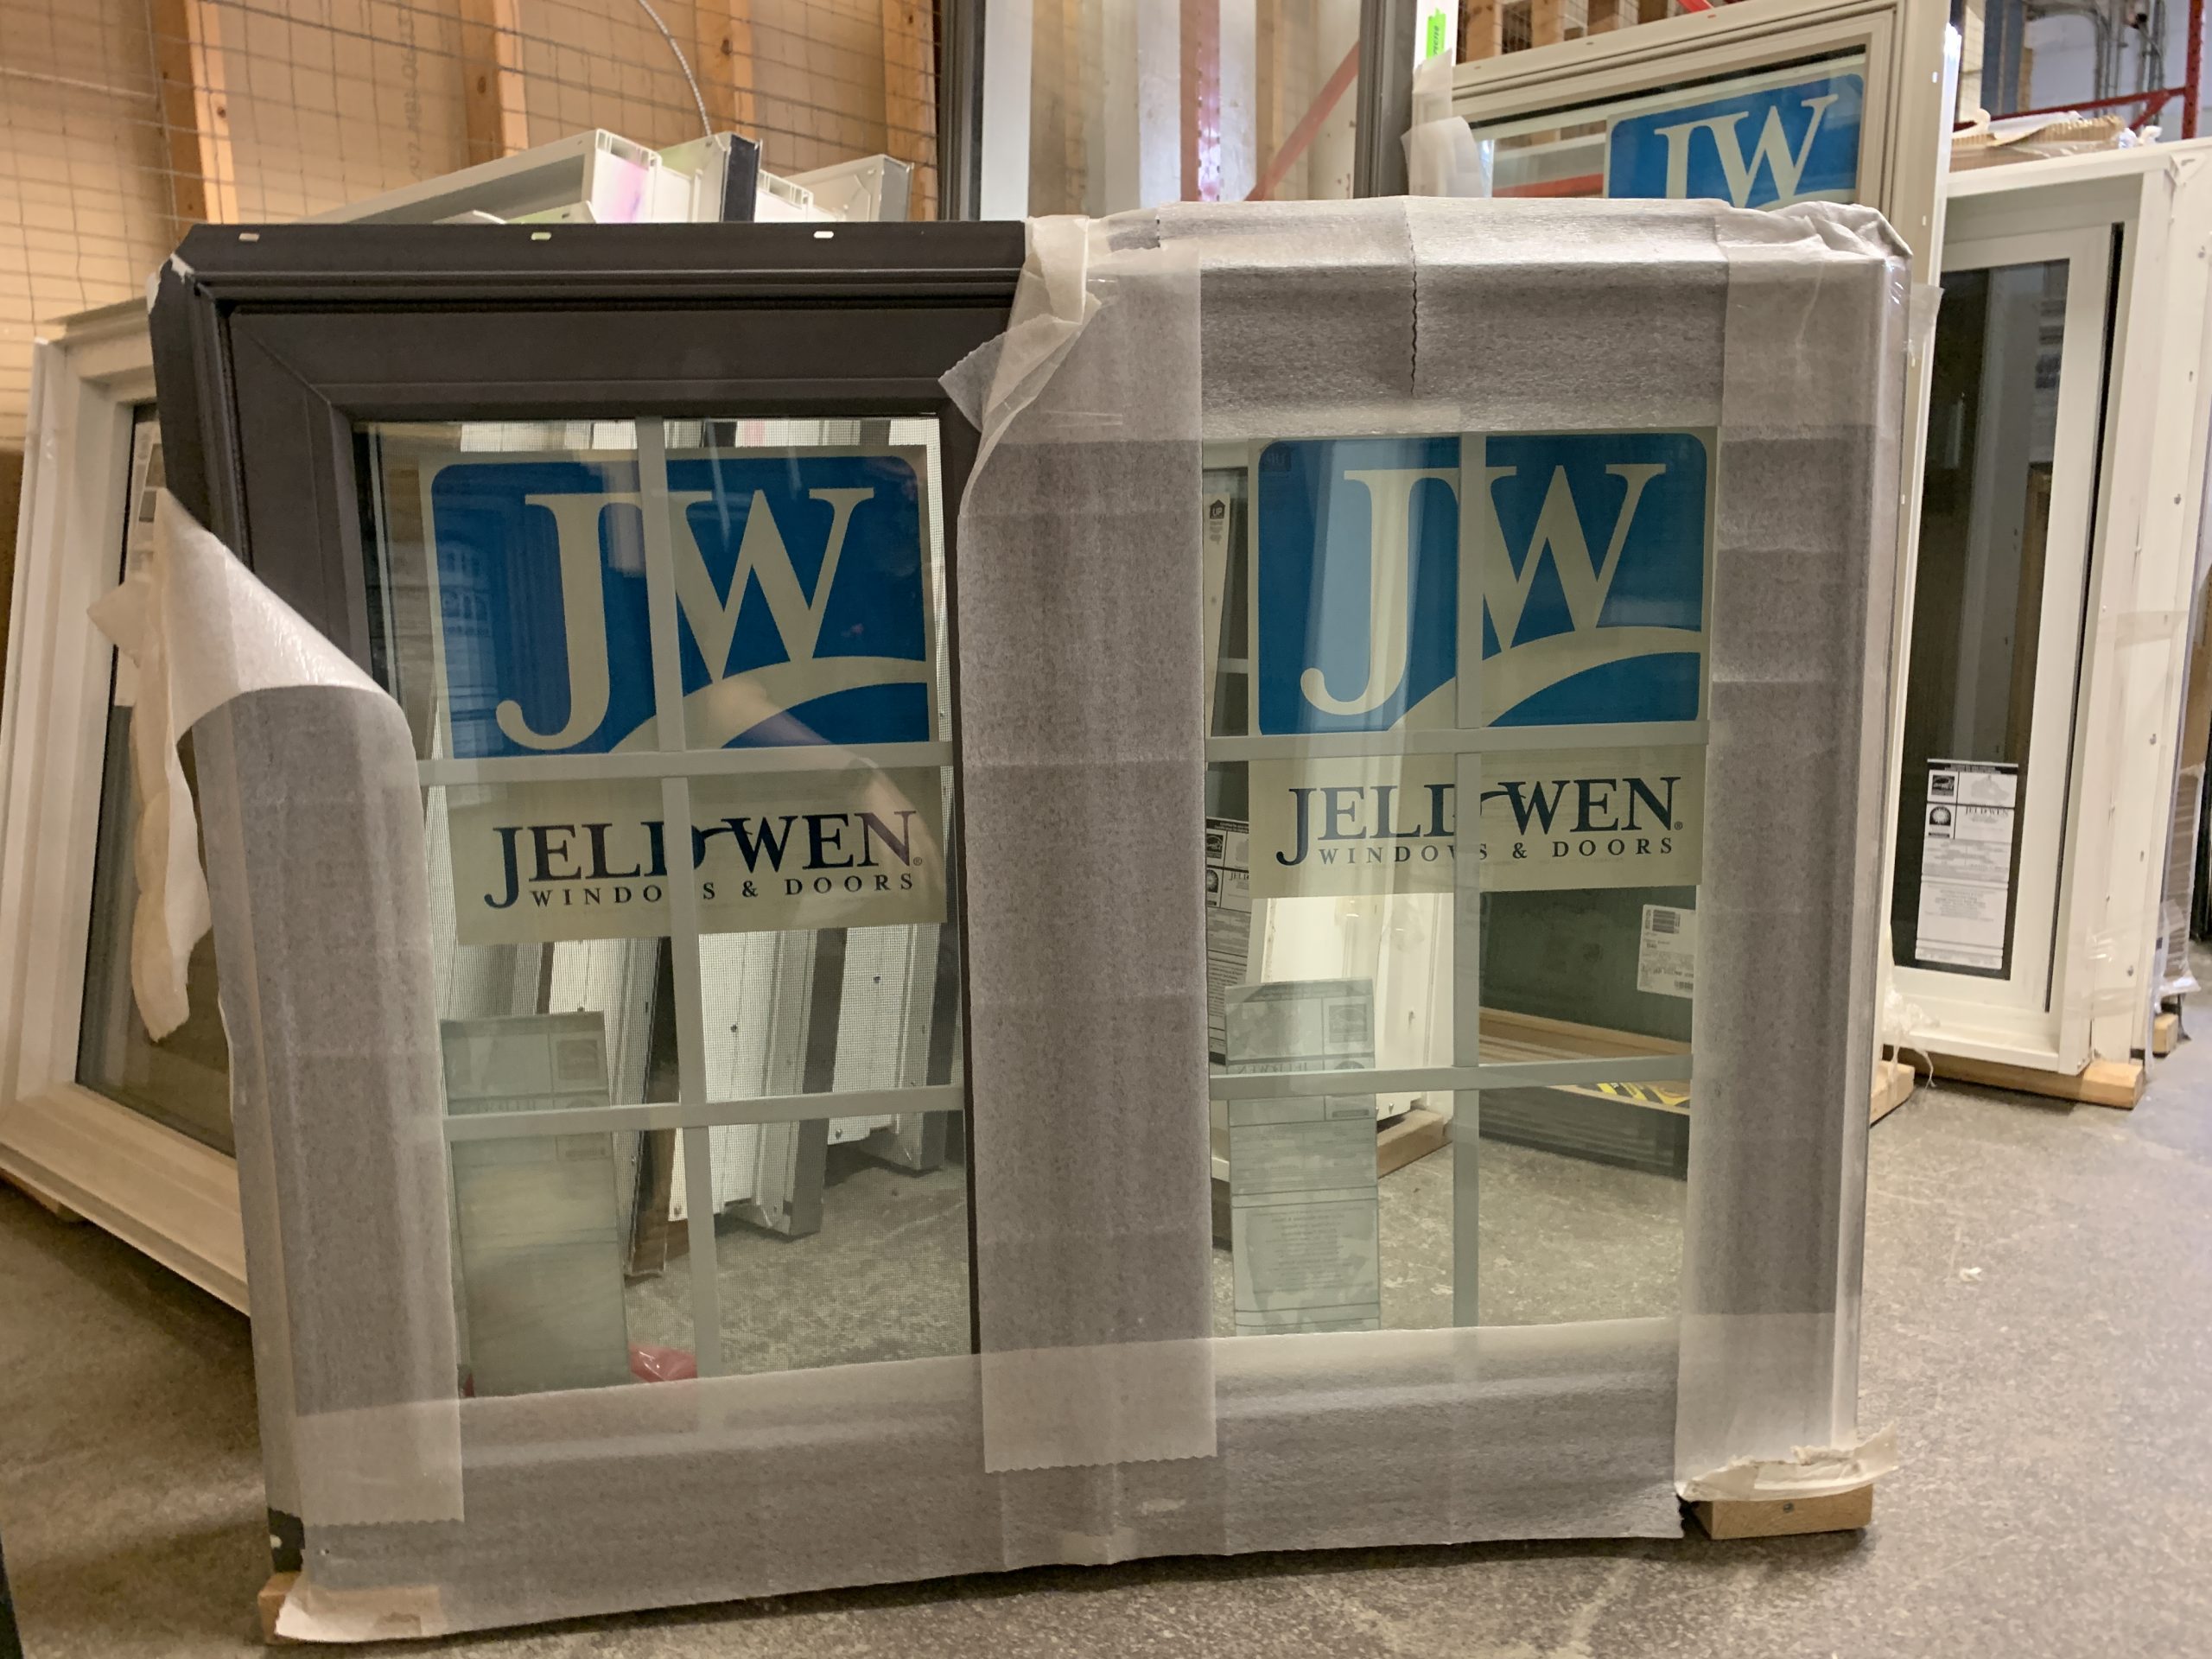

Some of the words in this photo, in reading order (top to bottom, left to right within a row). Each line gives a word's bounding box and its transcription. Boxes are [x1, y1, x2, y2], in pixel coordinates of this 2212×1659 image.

[496, 487, 874, 750] JW
[1300, 464, 1666, 715] JW
[530, 882, 715, 908] WINDOS
[742, 880, 759, 898] &
[785, 872, 914, 896] DOORS
[1319, 842, 1487, 866] WINDOS
[1512, 841, 1528, 859] &
[1553, 836, 1673, 857] DOORS
